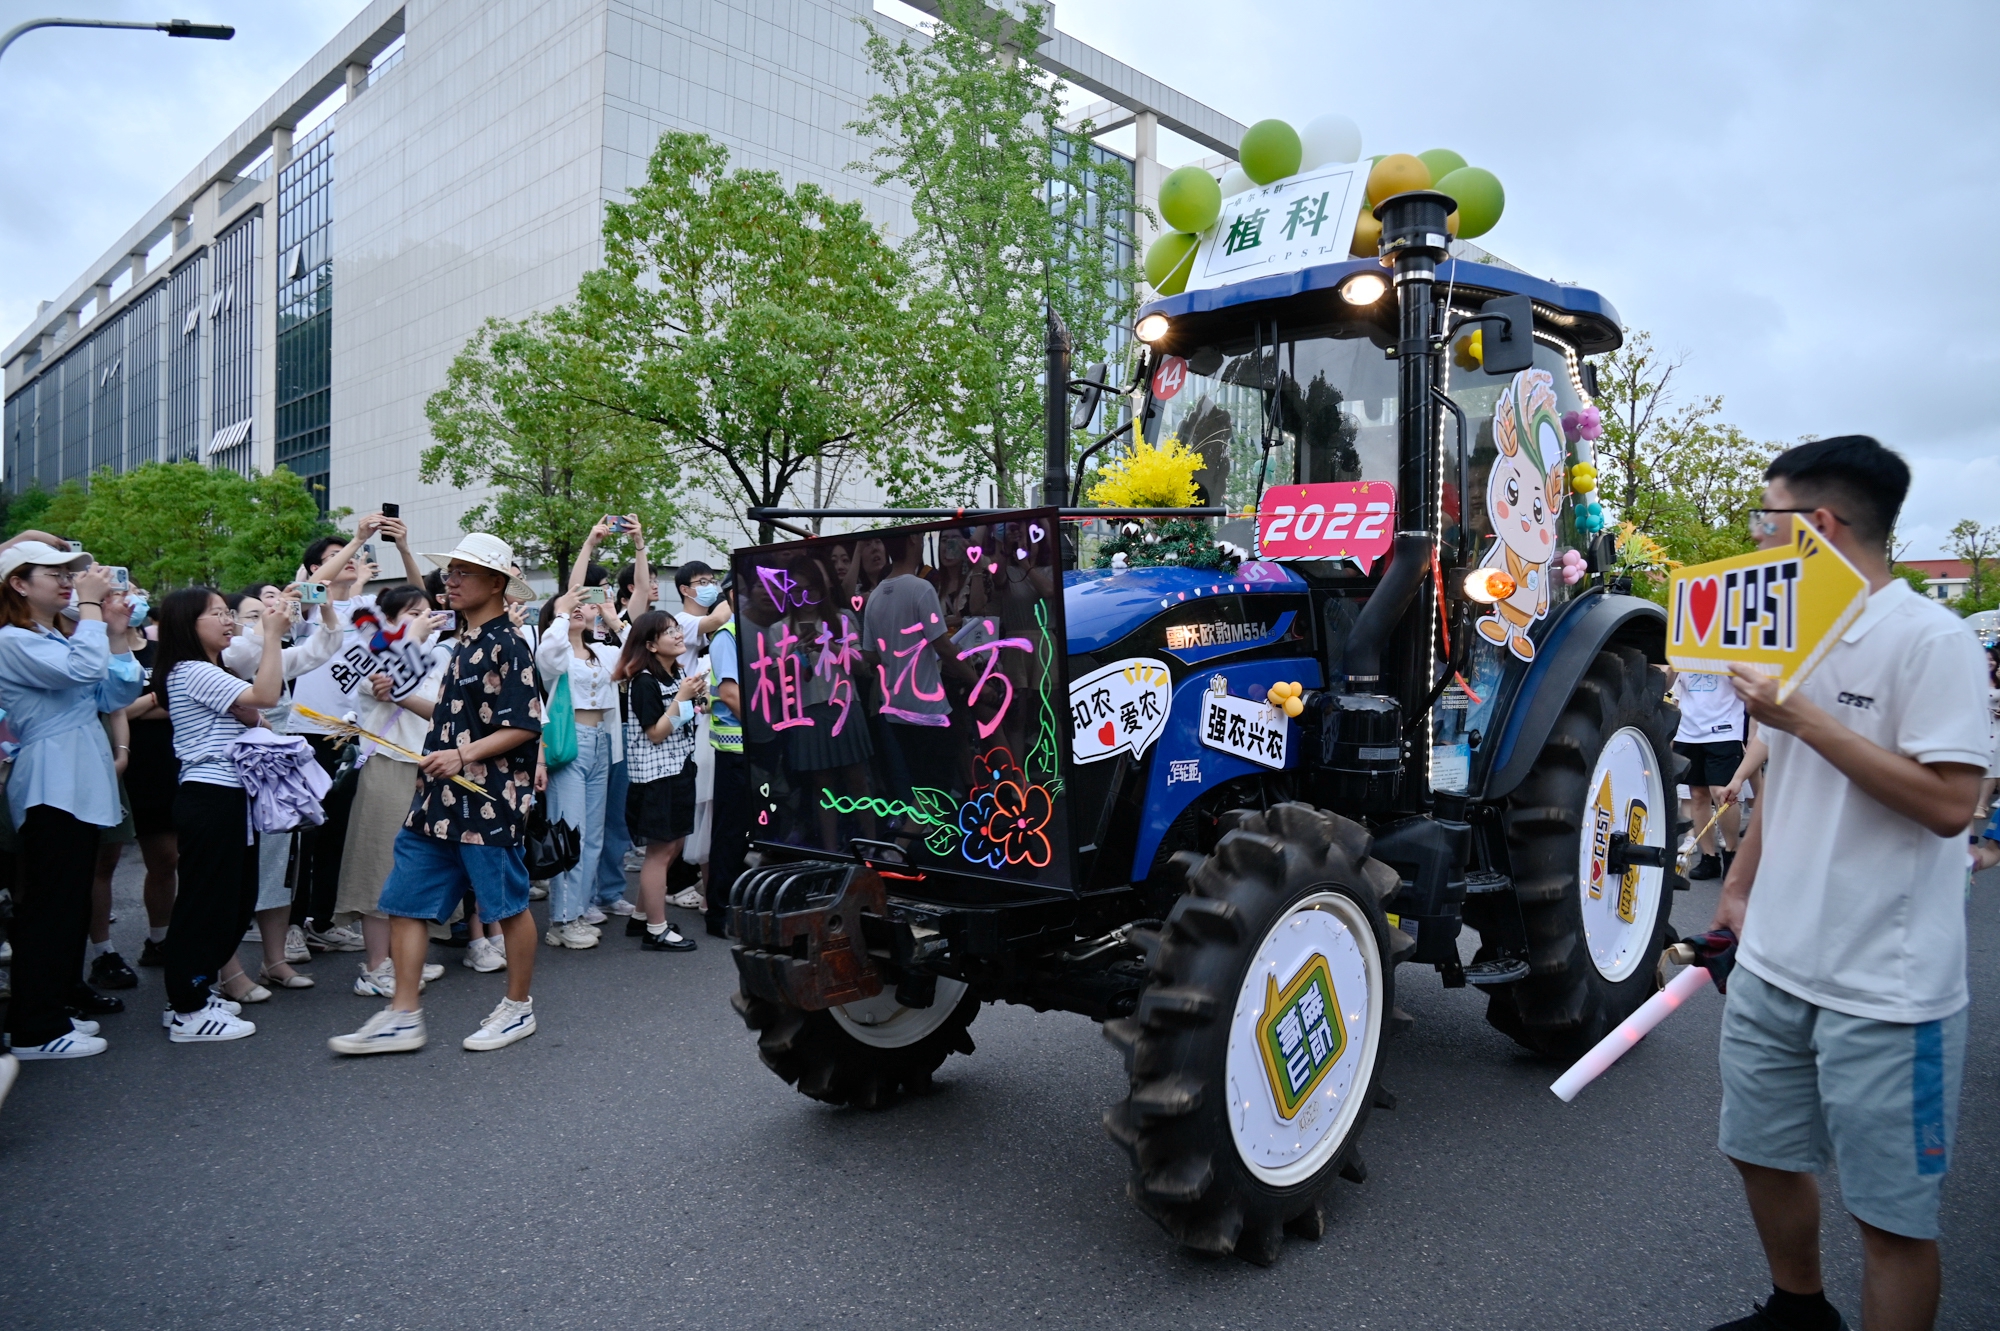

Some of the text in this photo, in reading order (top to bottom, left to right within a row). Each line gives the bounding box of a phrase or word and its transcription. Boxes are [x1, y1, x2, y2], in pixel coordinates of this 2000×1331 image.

[1222, 191, 1331, 257] 植科
[1267, 245, 1327, 264] CPST
[1156, 362, 1182, 393] 14
[1263, 501, 1391, 542] 2022
[1673, 559, 1800, 651] I CPST
[749, 613, 1034, 739] 植梦远方
[1687, 673, 1718, 692] 23
[1837, 691, 1875, 710] CPST
[1119, 688, 1162, 735] 爱农
[1206, 702, 1284, 761] 强农兴农
[1594, 806, 1611, 858] CPST
[1298, 977, 1335, 1071] 难忘
[1275, 1003, 1311, 1098] 狮山
